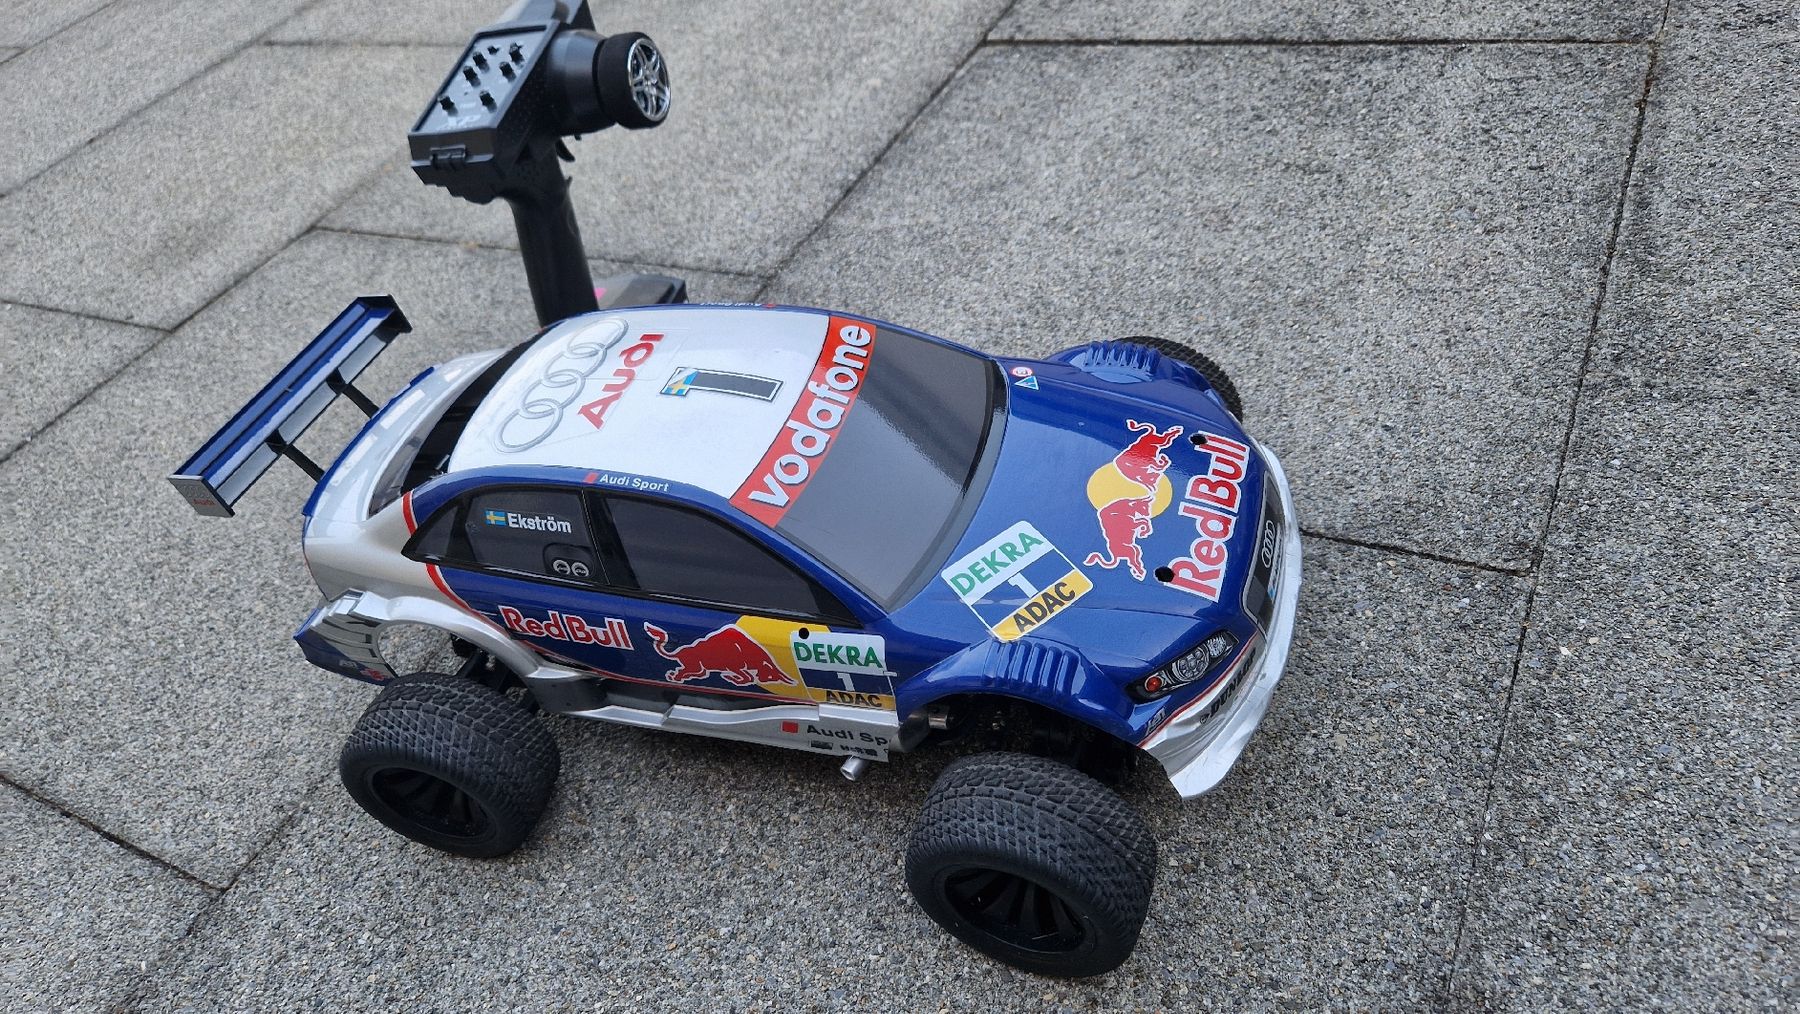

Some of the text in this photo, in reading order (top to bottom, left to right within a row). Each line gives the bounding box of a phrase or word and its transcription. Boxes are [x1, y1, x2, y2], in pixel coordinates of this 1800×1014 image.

[577, 333, 664, 431] Audi
[748, 325, 873, 508] vodafone
[600, 474, 669, 493] Audi Sport
[507, 512, 572, 533] Ekström
[1166, 431, 1249, 603] Red Bull
[950, 532, 1044, 596] DEKRA
[1007, 572, 1039, 598] 1
[1013, 581, 1076, 633] ADAC
[498, 605, 634, 650] Red Bull
[793, 641, 883, 668] DEKRA
[837, 672, 855, 692] 1
[826, 690, 883, 708] ADAC
[807, 725, 890, 746] Audi Sp
